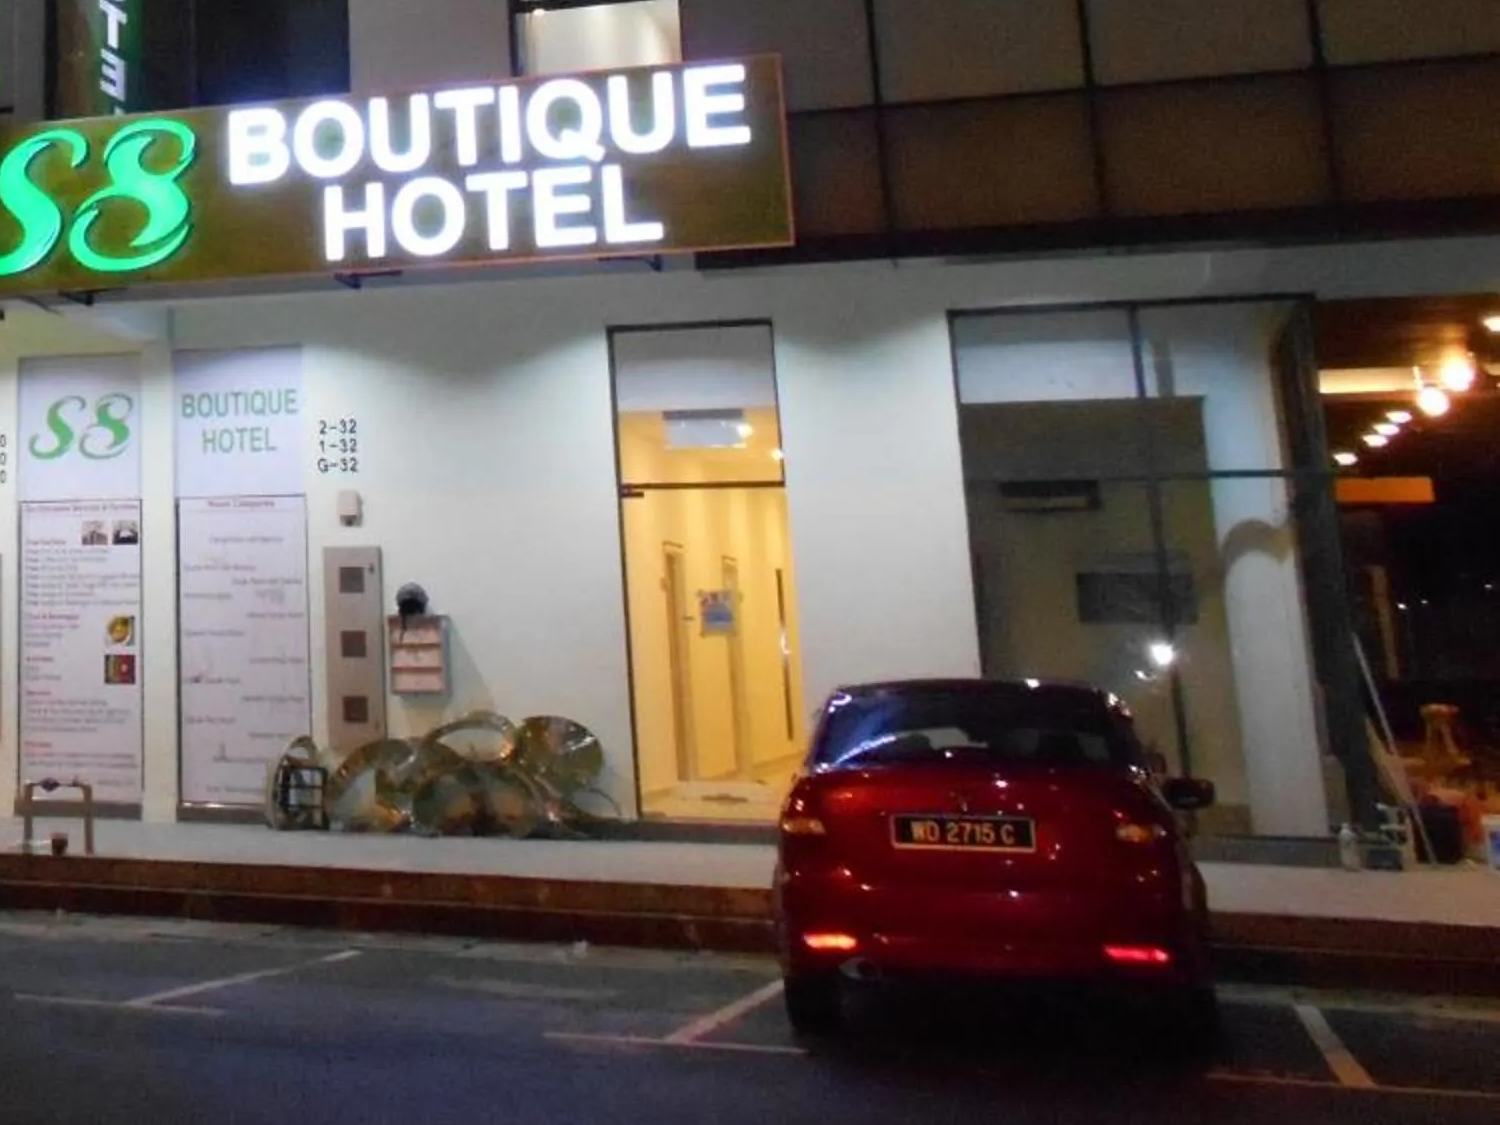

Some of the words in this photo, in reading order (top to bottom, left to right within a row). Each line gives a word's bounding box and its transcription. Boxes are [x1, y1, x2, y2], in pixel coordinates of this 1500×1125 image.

[226, 63, 753, 186] BOUTIQUE
[323, 164, 665, 262] HOTEL
[180, 388, 300, 419] BOUTIQUE
[318, 418, 357, 435] 2-32
[202, 426, 278, 455] HOTEL
[318, 437, 358, 454] 1-32
[317, 456, 359, 474] G-32
[946, 821, 997, 844] 2715
[1000, 823, 1015, 845] C
